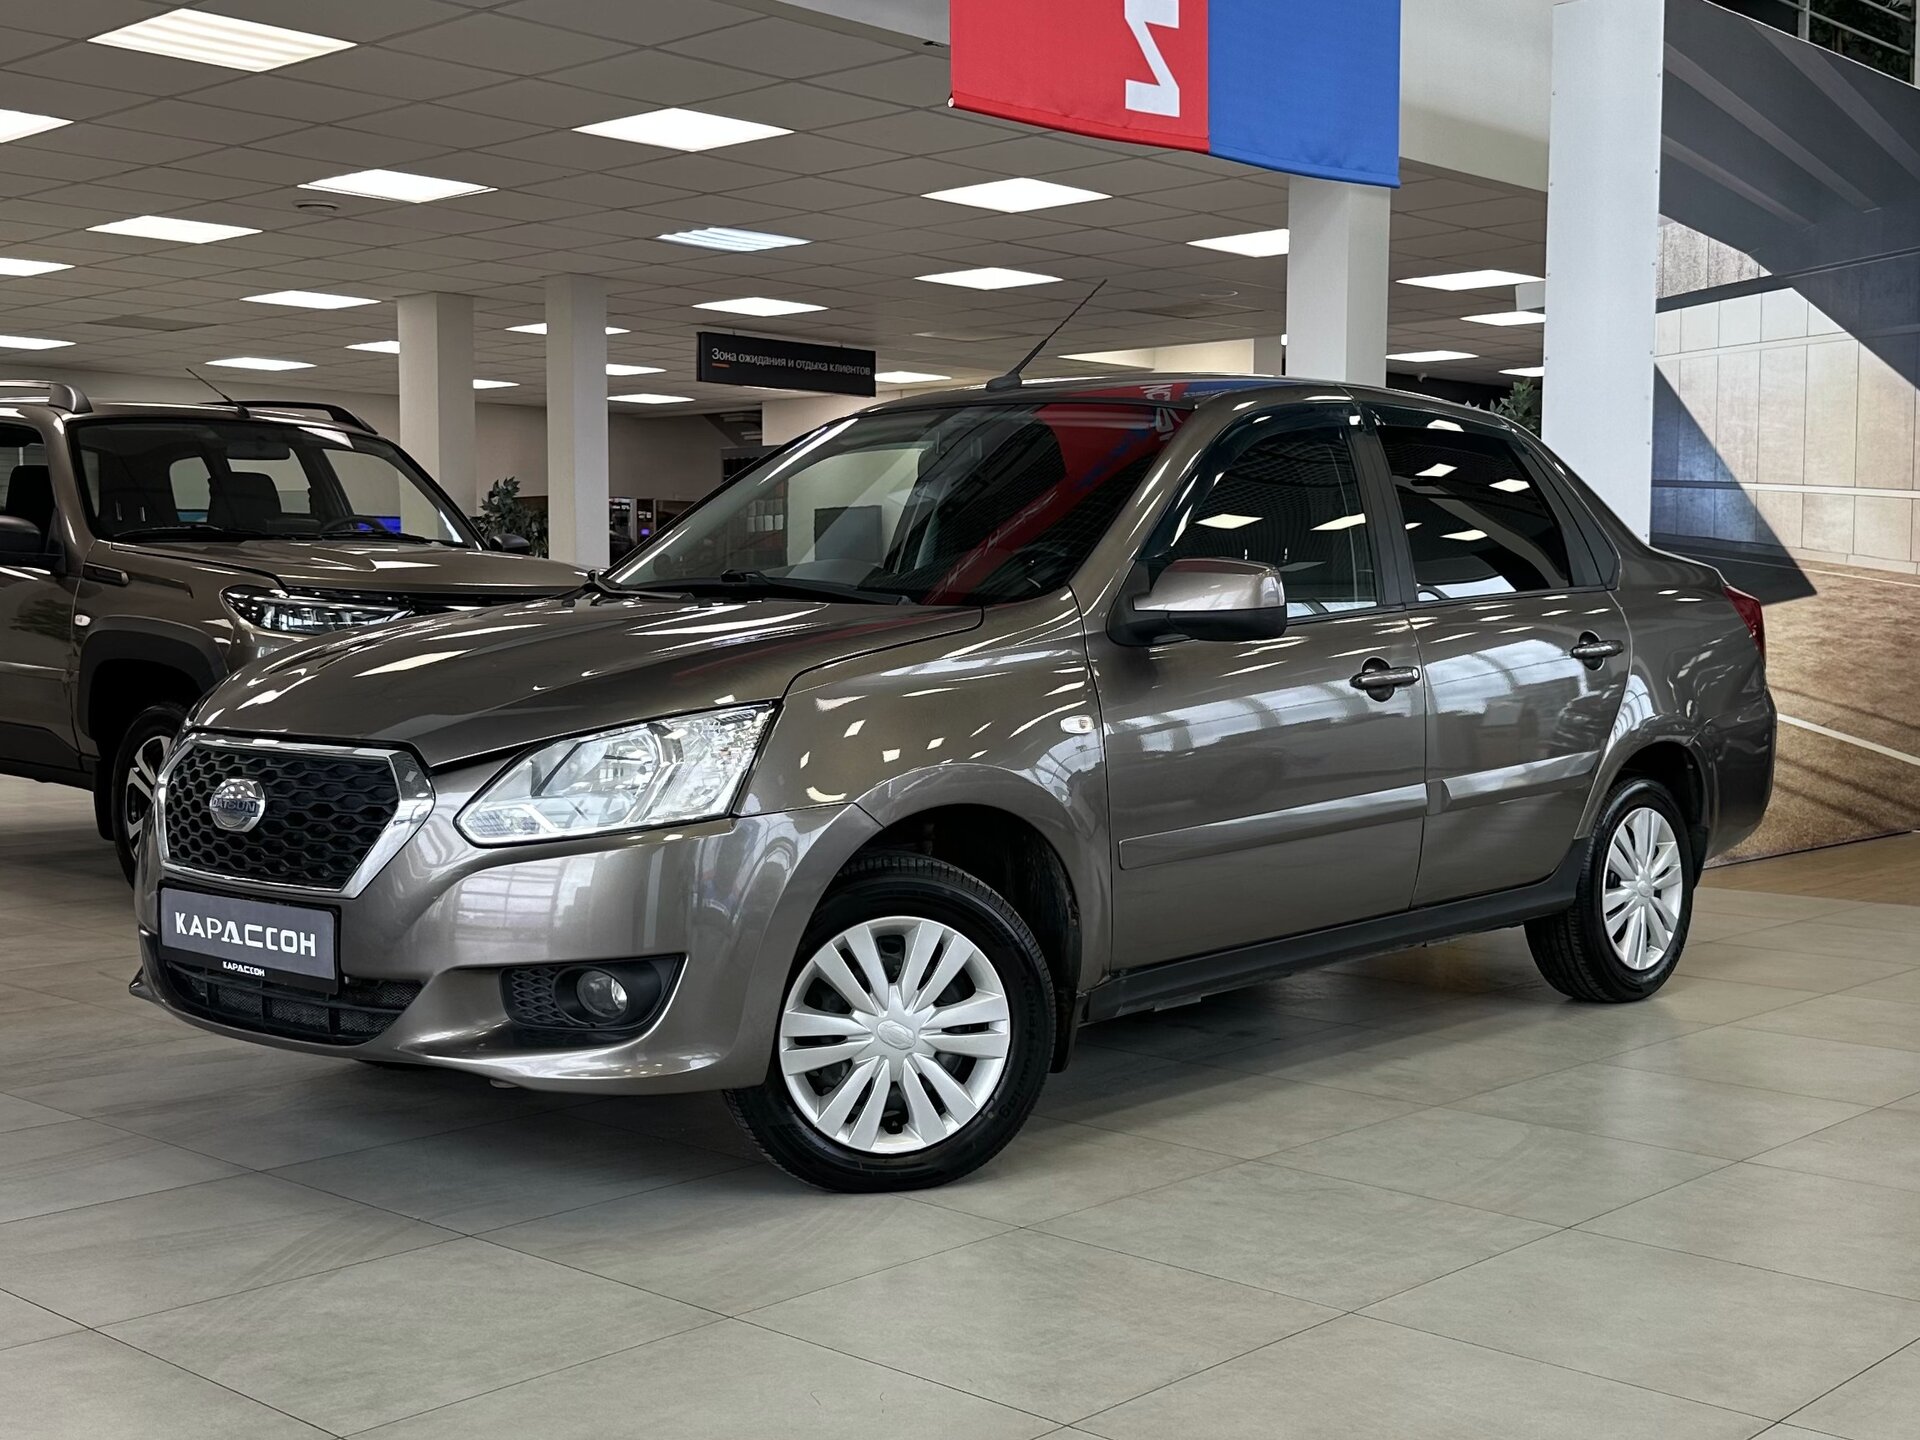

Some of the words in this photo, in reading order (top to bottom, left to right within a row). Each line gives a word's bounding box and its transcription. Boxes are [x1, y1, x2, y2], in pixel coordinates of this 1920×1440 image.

[711, 347, 737, 361] Зона
[738, 354, 787, 367] ожидания
[796, 361, 828, 371] отдыха
[829, 363, 871, 375] клиентов
[212, 798, 256, 812] DATSUN
